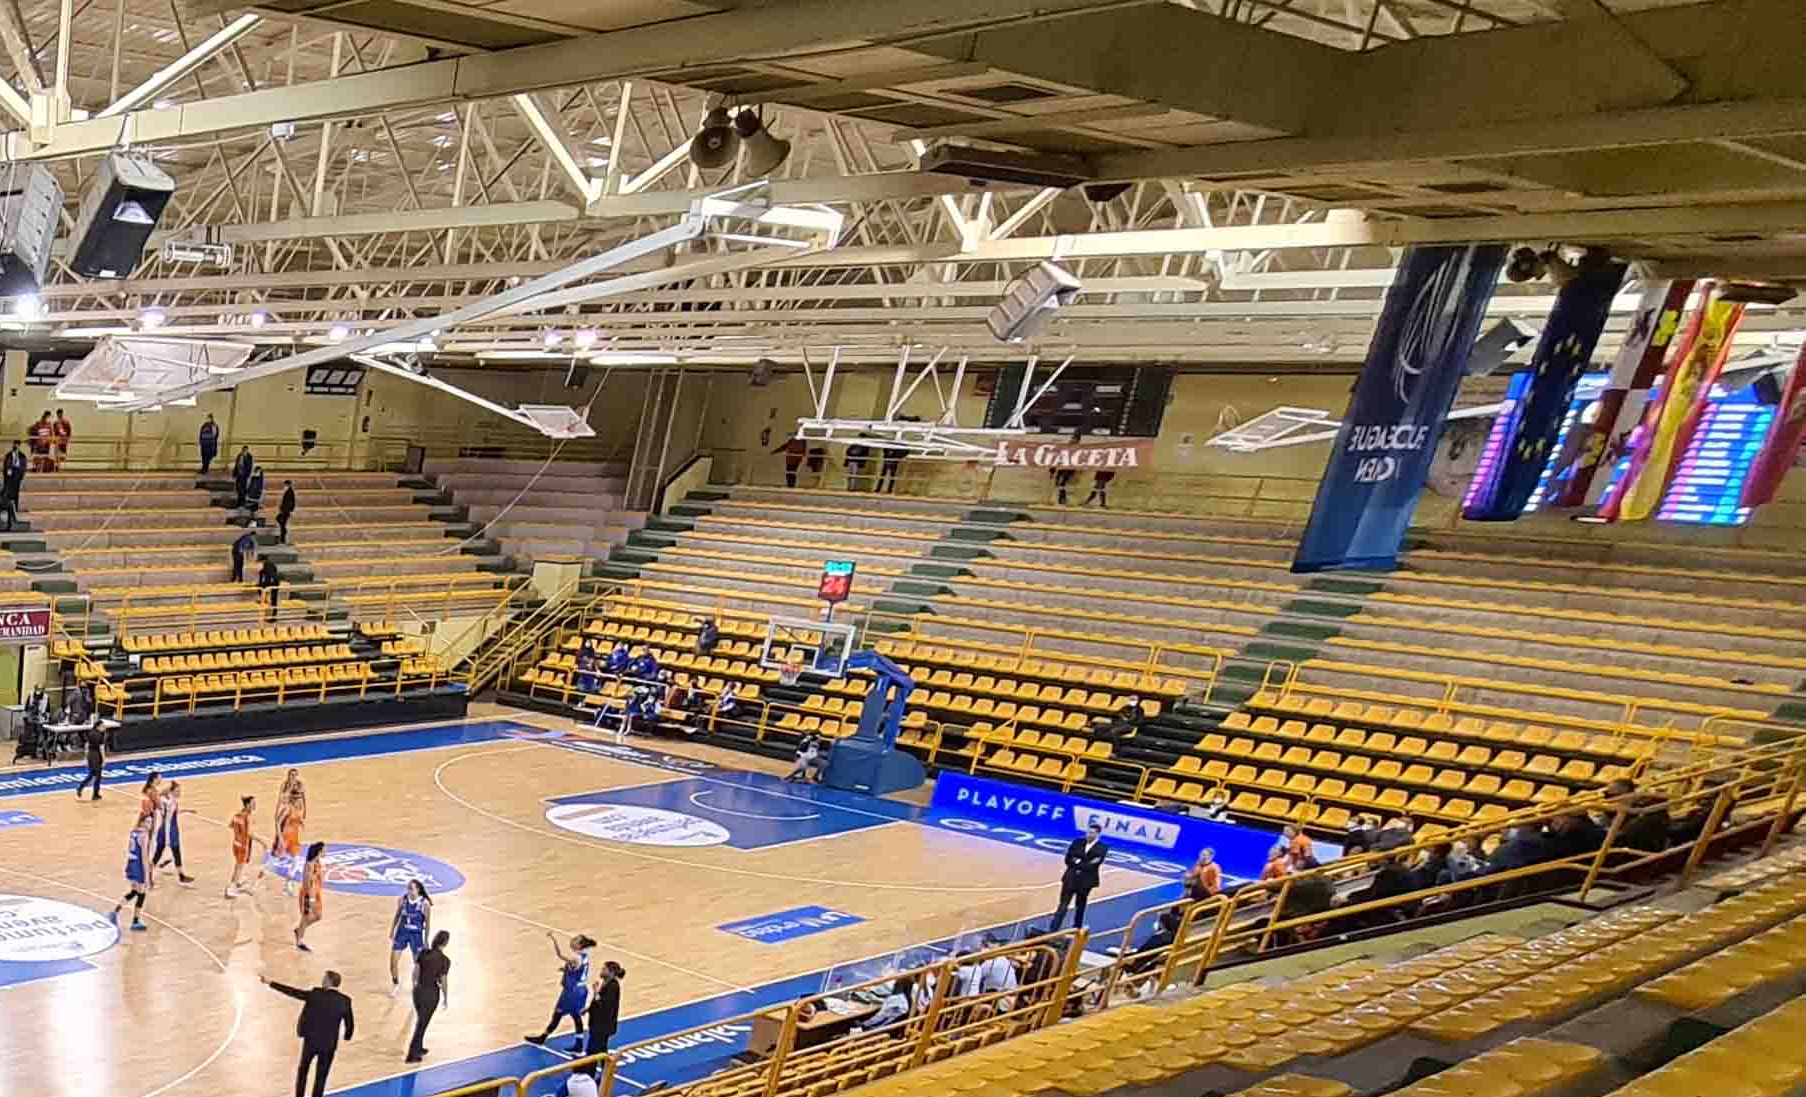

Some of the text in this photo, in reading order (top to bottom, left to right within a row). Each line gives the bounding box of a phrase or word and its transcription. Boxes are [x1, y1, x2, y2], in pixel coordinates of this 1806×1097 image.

[1033, 444, 1139, 467] GACETA
[956, 787, 1170, 843] PLAYOFF FINAL
